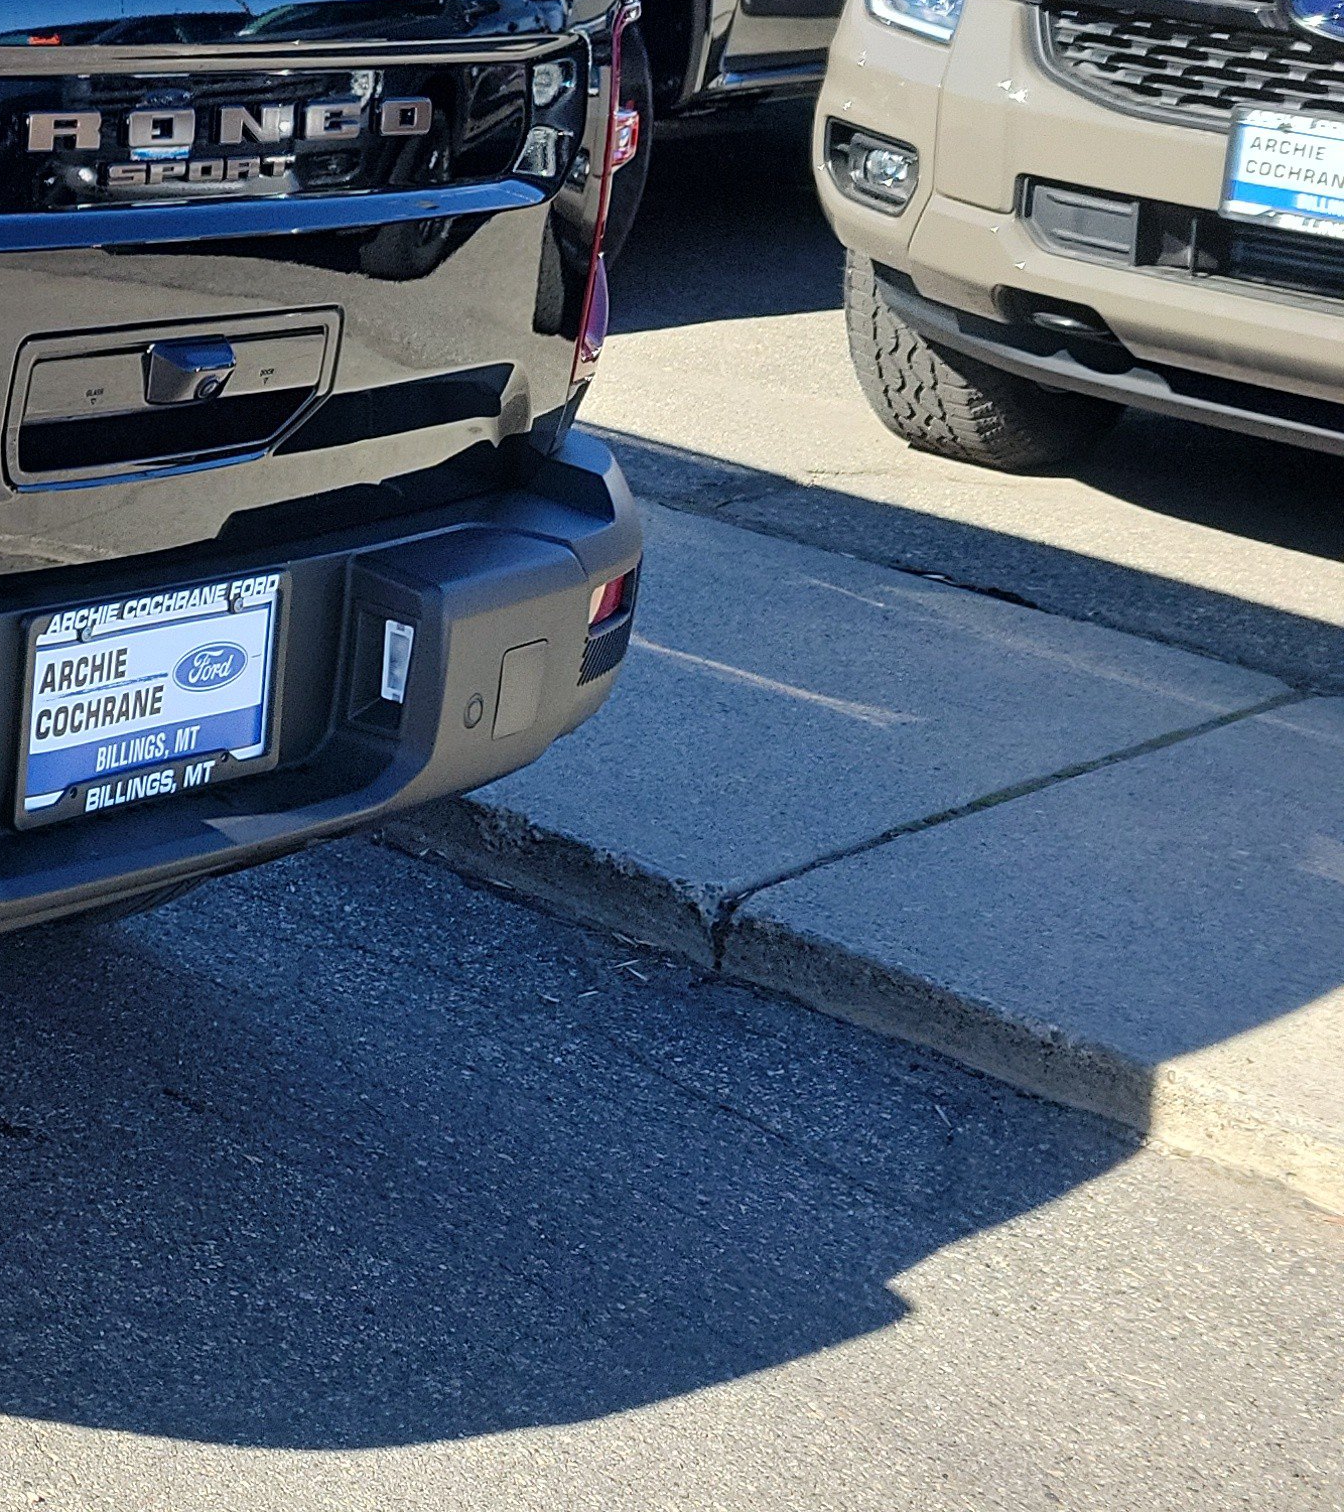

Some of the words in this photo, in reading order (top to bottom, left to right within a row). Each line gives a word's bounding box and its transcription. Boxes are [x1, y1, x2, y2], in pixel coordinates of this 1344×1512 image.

[108, 154, 296, 186] SPORT
[1250, 137, 1327, 160] ARCHIE
[46, 603, 121, 635] ARCHIE
[123, 583, 229, 620] COCHRANE
[229, 574, 280, 601] FORD
[38, 648, 129, 694] ARCHIE
[188, 650, 232, 684] Ford
[35, 684, 165, 741] COCHRANE
[96, 731, 170, 773] BILLINGS,
[174, 725, 201, 752] MT
[85, 770, 177, 813] BILLINGS,
[183, 760, 216, 789] MT
